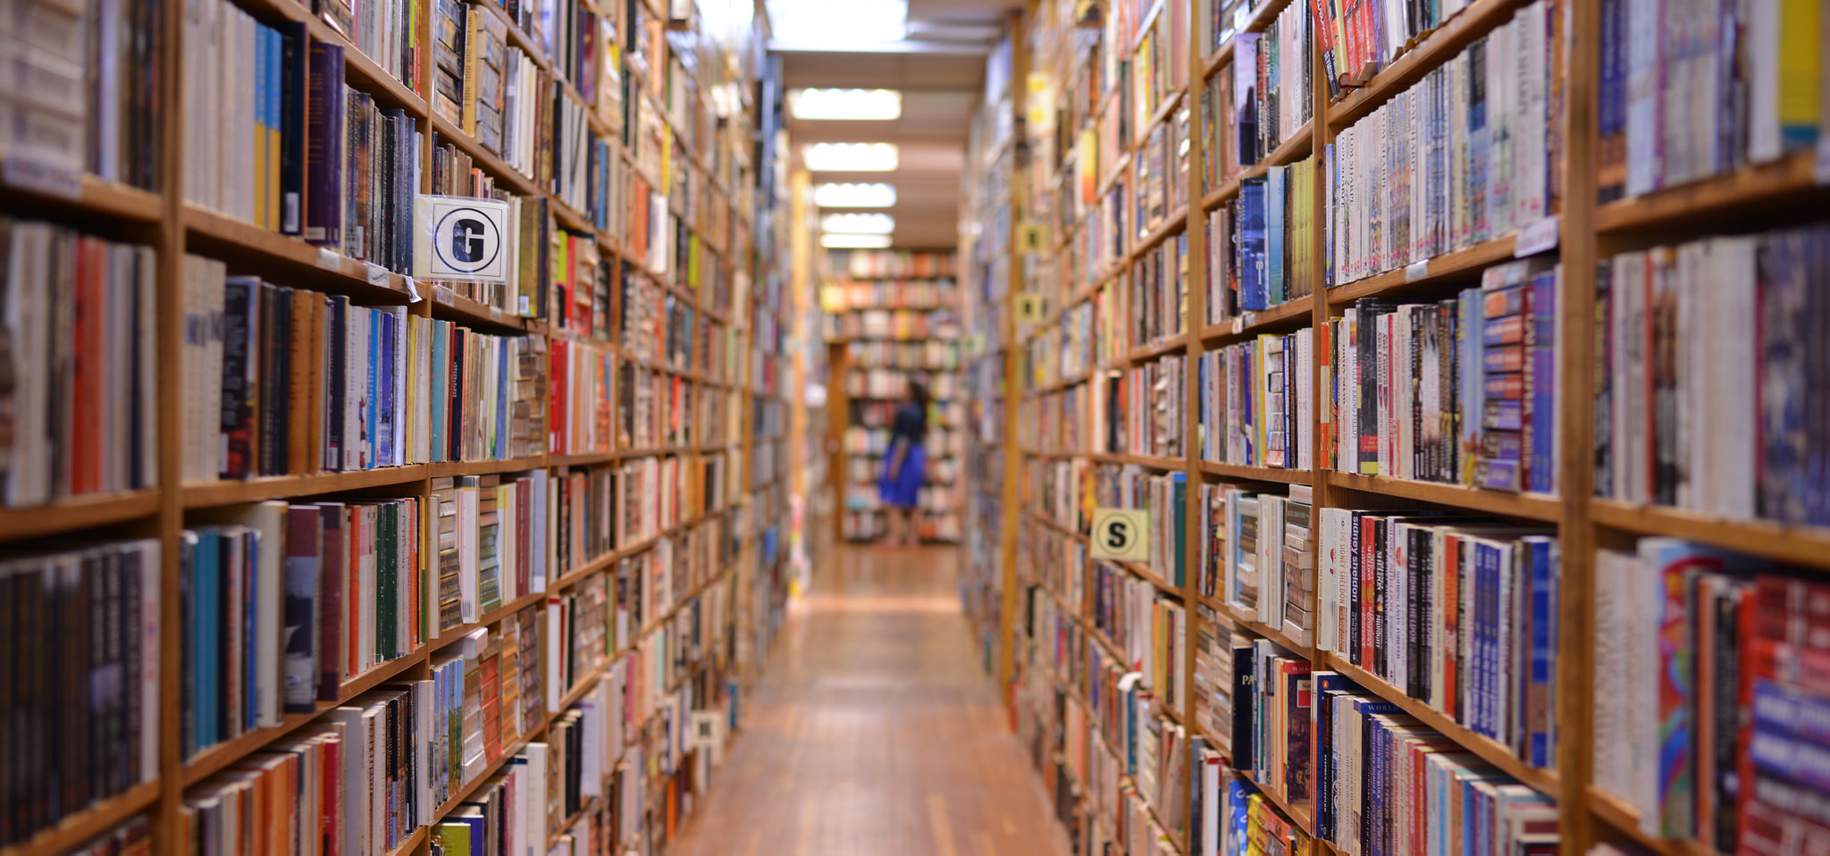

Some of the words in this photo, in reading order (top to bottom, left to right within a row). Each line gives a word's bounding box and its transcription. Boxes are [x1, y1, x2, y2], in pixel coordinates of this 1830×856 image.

[452, 218, 484, 263] G
[1107, 522, 1127, 548] S
[1351, 516, 1359, 556] sidney
[1409, 571, 1417, 602] SIDNEY
[1409, 603, 1417, 643] SHELDON
